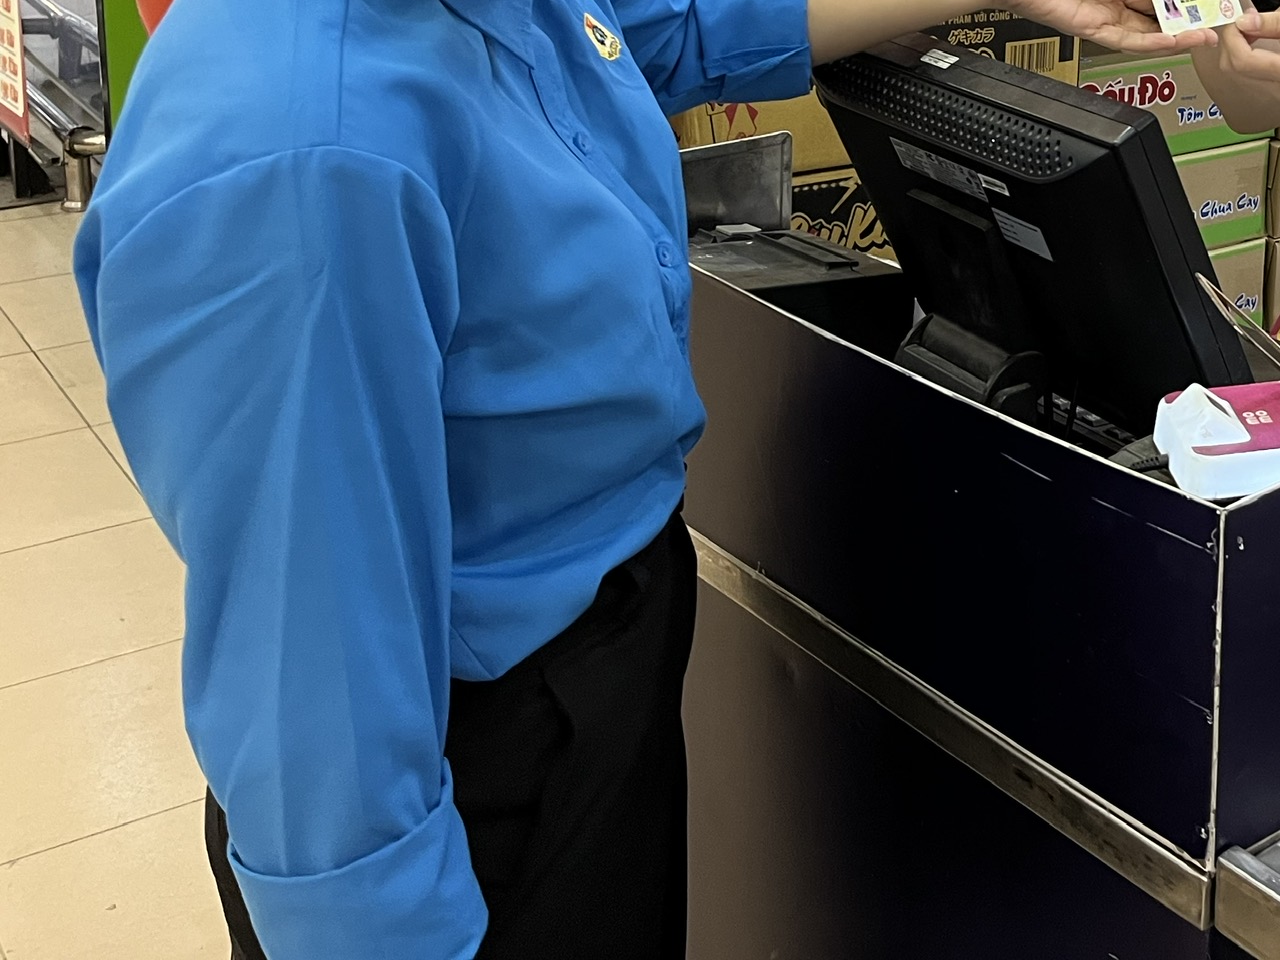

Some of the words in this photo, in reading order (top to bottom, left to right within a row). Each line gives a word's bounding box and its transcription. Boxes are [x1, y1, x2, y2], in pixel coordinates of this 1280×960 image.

[973, 12, 988, 23] VỚI
[989, 10, 1011, 22] CÔNG
[948, 26, 996, 46] ゲキカラ
[1136, 70, 1177, 107] Đỏ
[1176, 105, 1204, 127] Tôm
[1200, 198, 1233, 220] Chua
[1236, 191, 1261, 213] Cay
[1234, 292, 1259, 313] Cay
